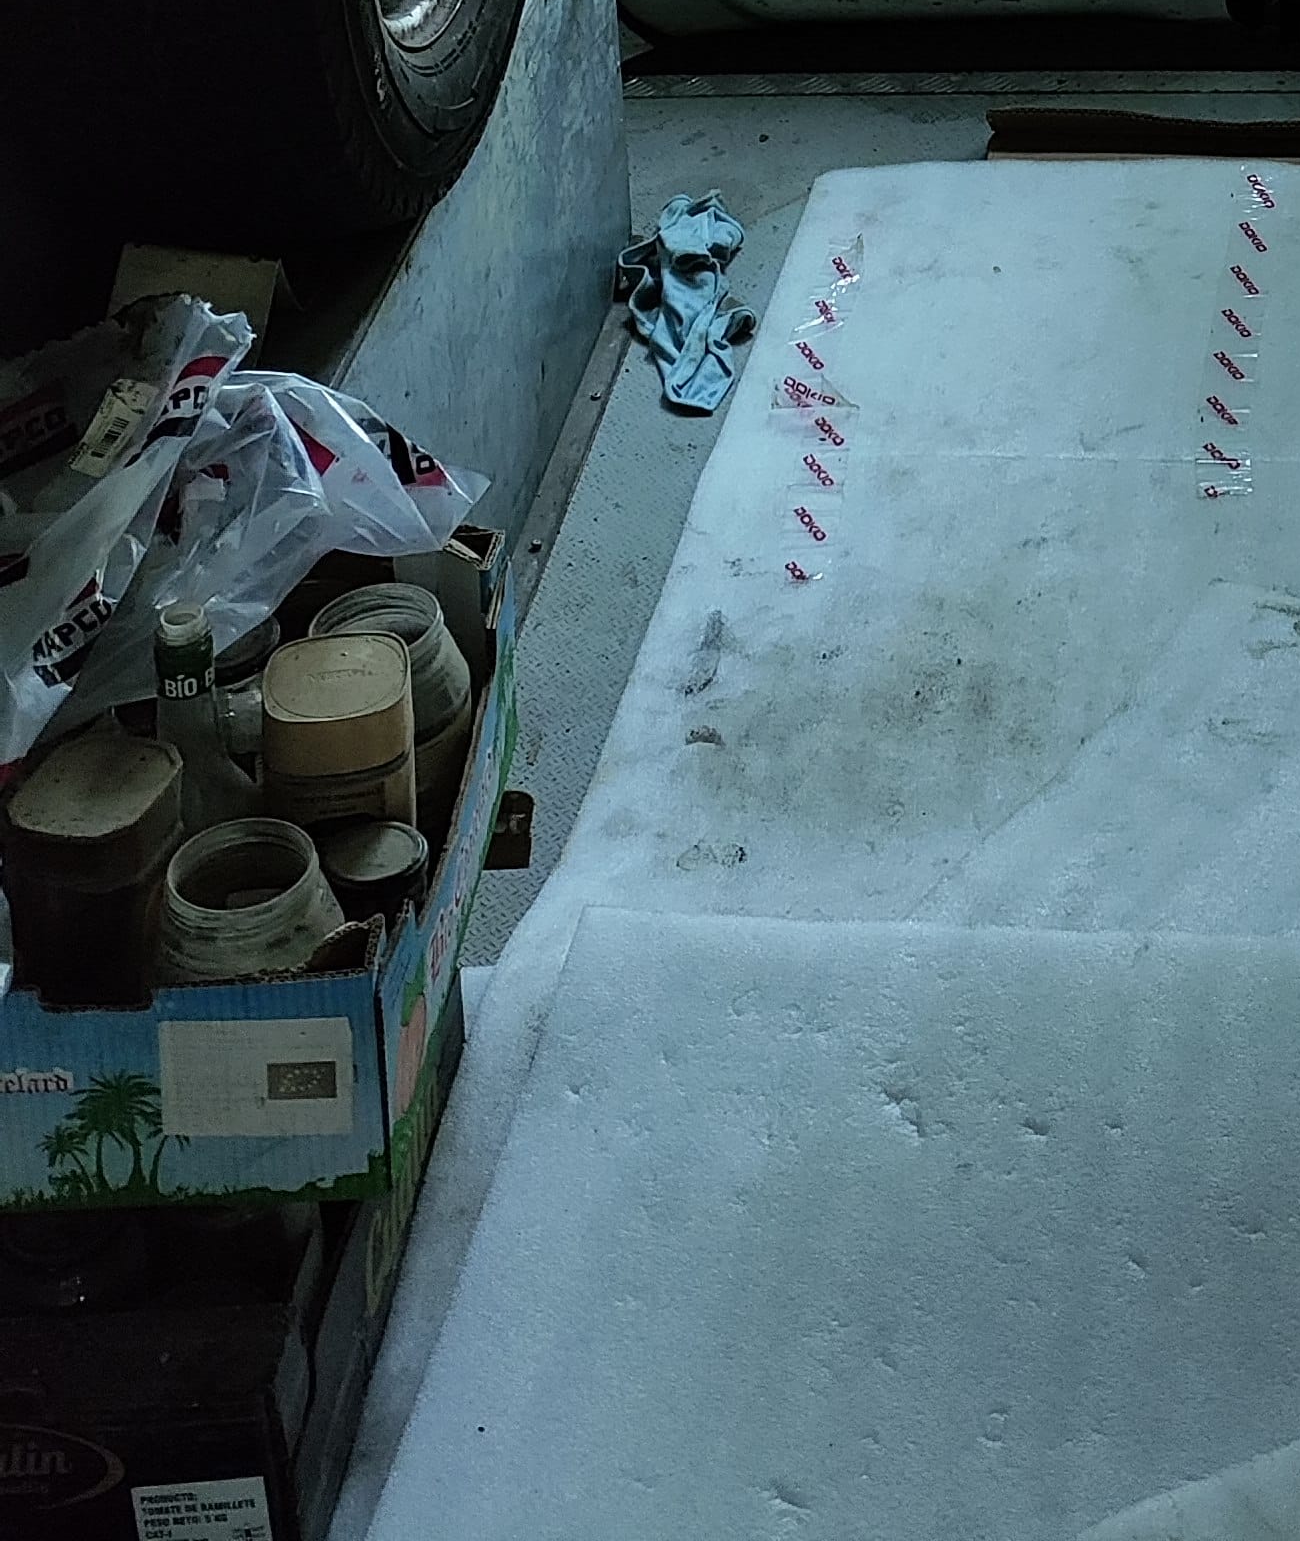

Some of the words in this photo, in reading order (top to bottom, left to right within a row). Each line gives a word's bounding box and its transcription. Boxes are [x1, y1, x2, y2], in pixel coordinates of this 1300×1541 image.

[1239, 222, 1267, 252] DOKIO
[1230, 265, 1259, 297] DOKIO
[1221, 309, 1251, 337] DOKIO
[795, 342, 824, 370] DOKIO
[1213, 351, 1245, 380] DOKIO
[784, 376, 836, 406] DOKIO
[803, 454, 834, 486] DOKIO
